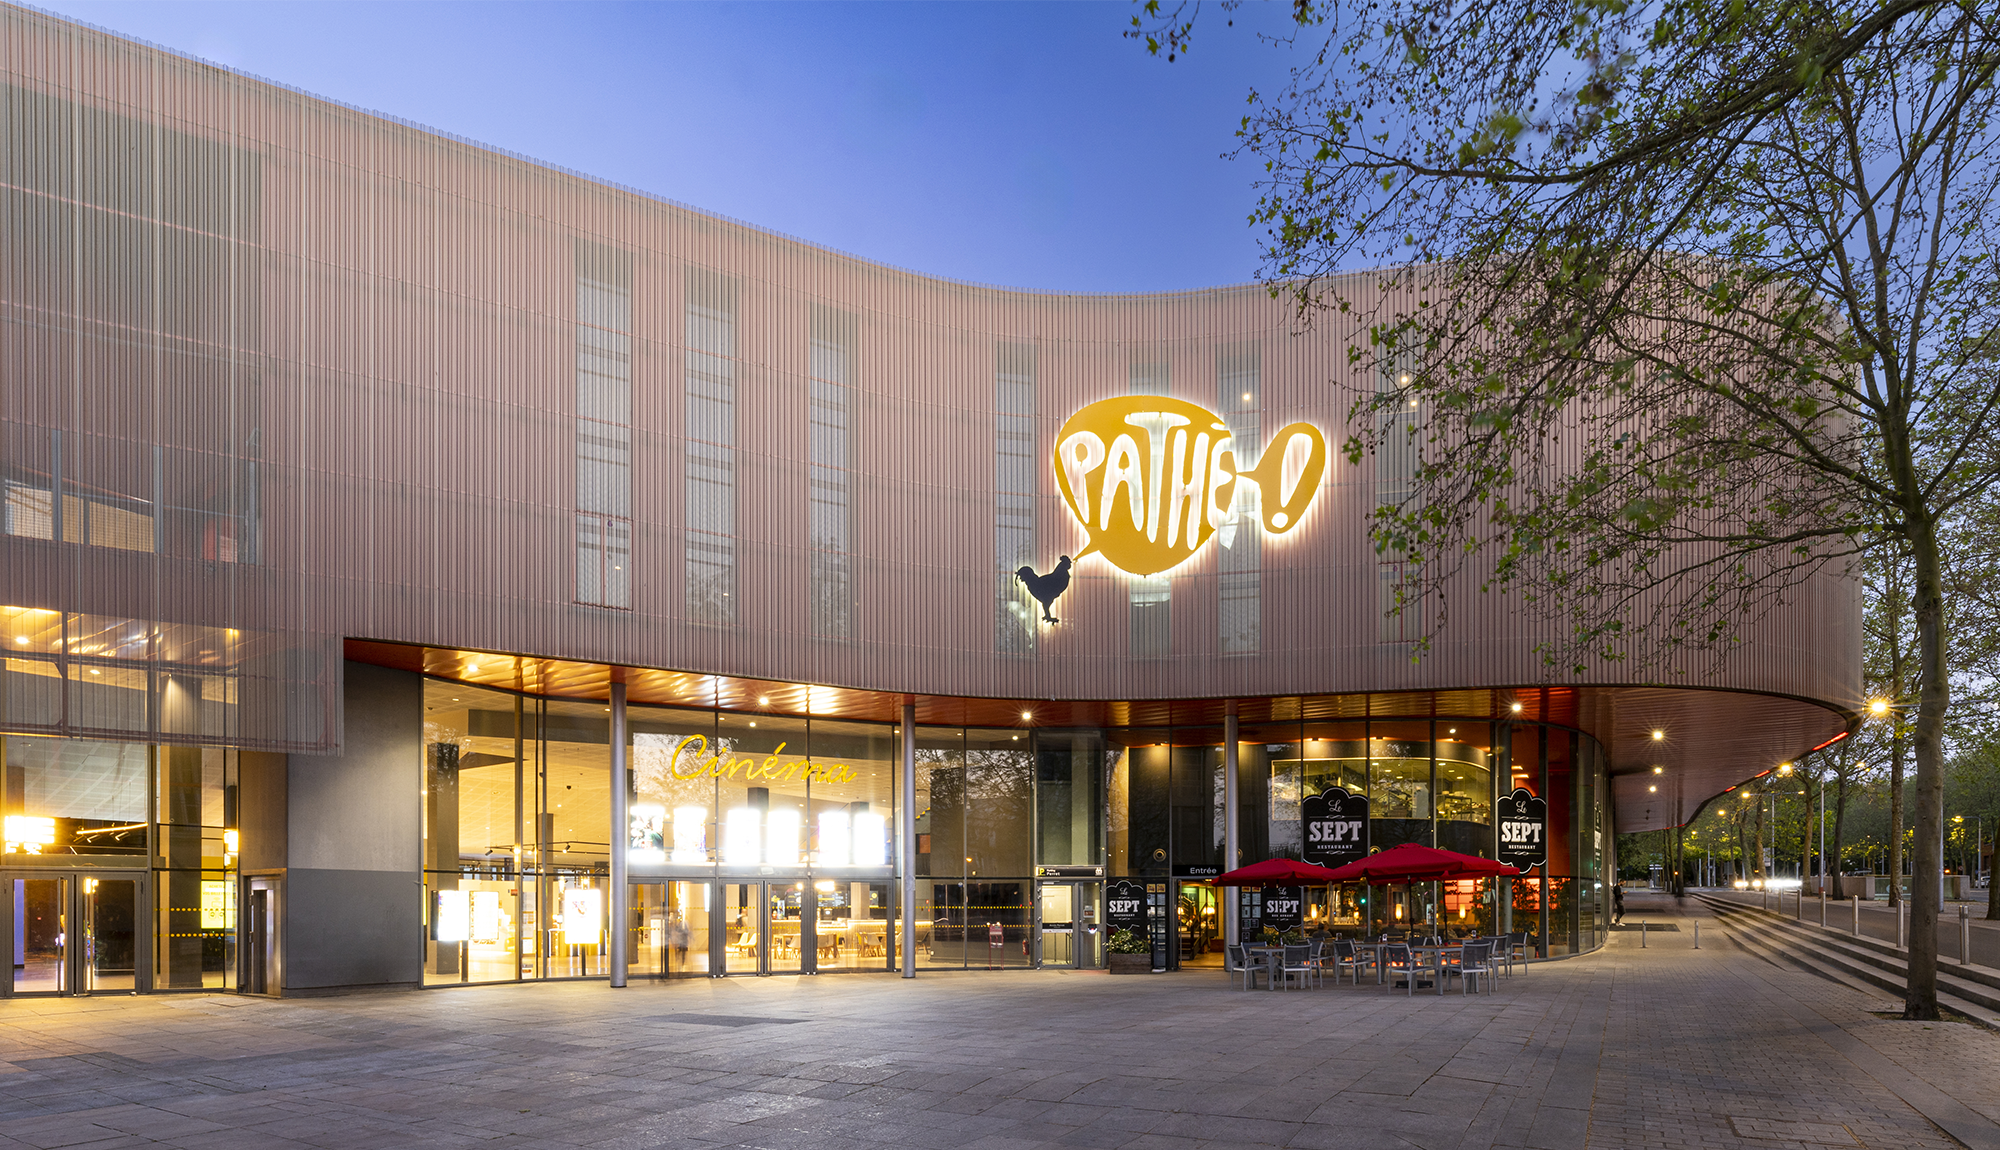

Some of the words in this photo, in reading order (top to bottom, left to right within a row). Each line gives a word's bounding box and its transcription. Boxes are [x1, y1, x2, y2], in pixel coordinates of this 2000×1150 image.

[671, 734, 857, 784] Cinéma
[1328, 799, 1342, 812] Le
[1309, 821, 1362, 842] SEPT
[1501, 821, 1542, 843] SEPT
[1108, 900, 1140, 913] SEPT
[1266, 900, 1299, 913] SEPT
